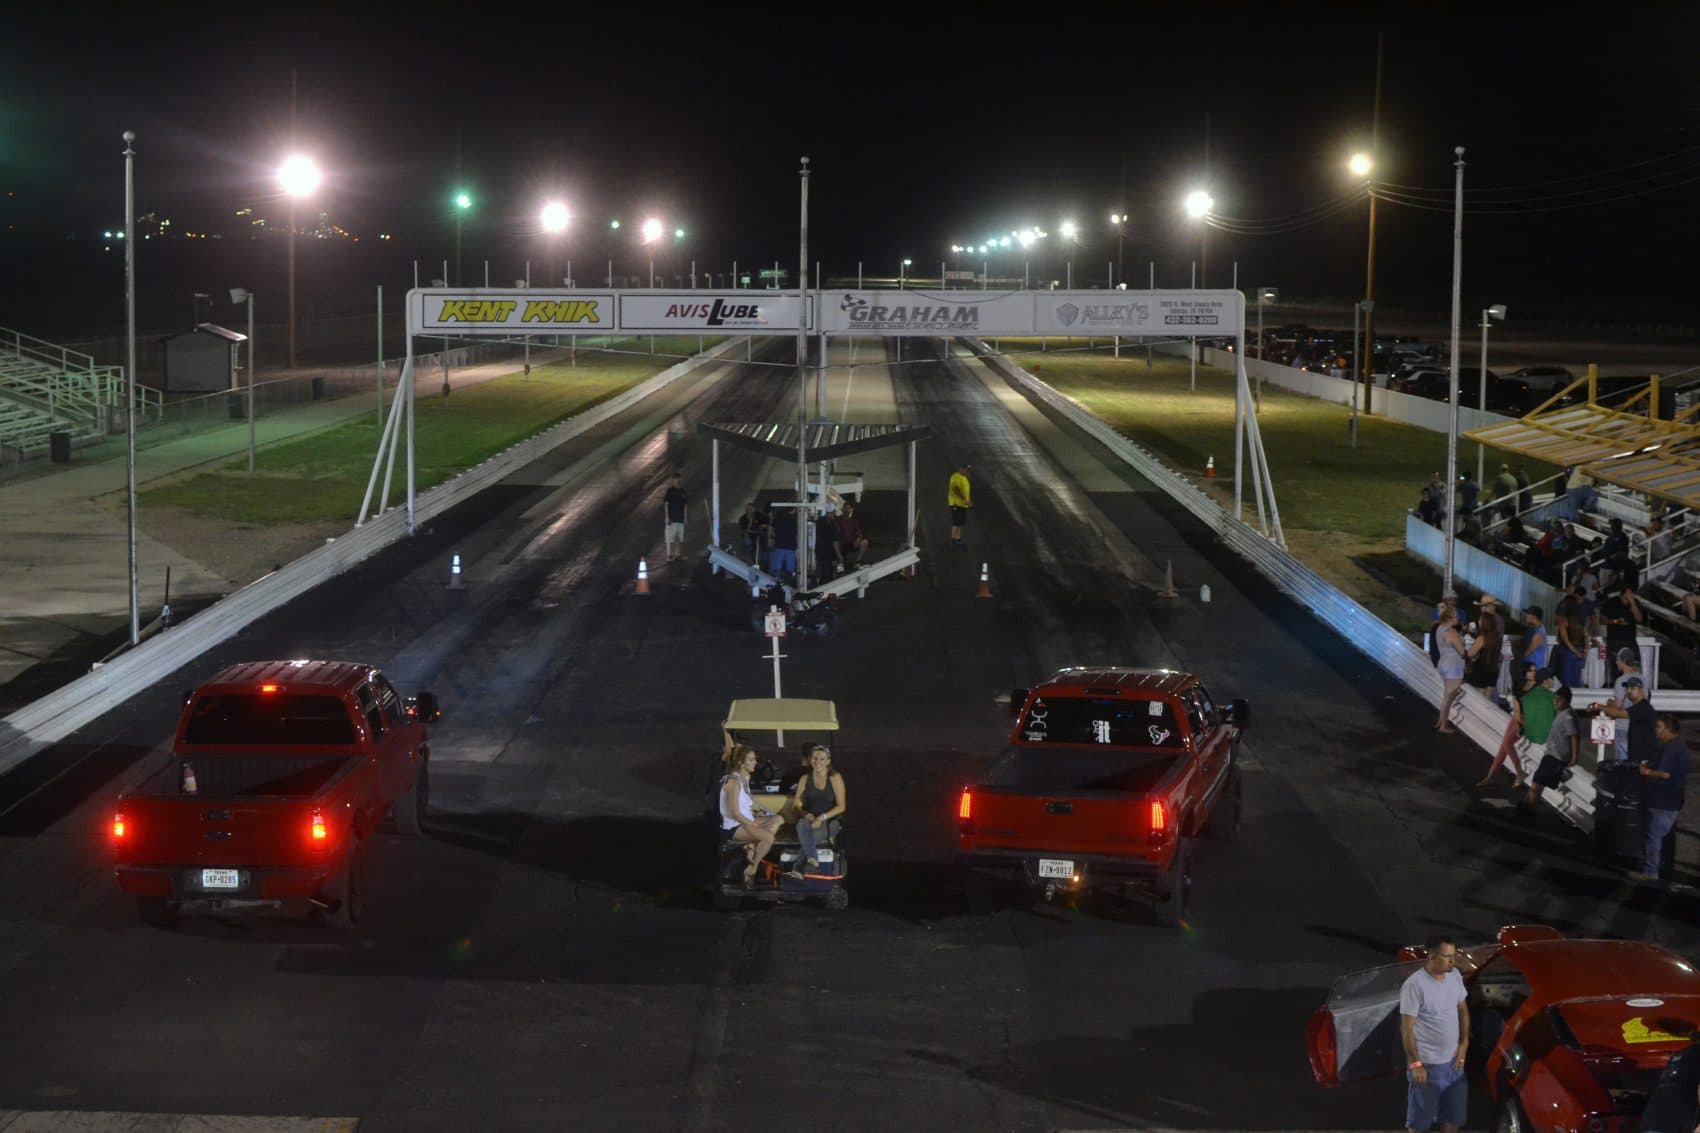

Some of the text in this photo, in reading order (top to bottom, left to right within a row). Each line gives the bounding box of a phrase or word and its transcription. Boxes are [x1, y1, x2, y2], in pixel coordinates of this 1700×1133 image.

[438, 301, 599, 323] KENT KWIK
[850, 305, 978, 321] GRAHAM
